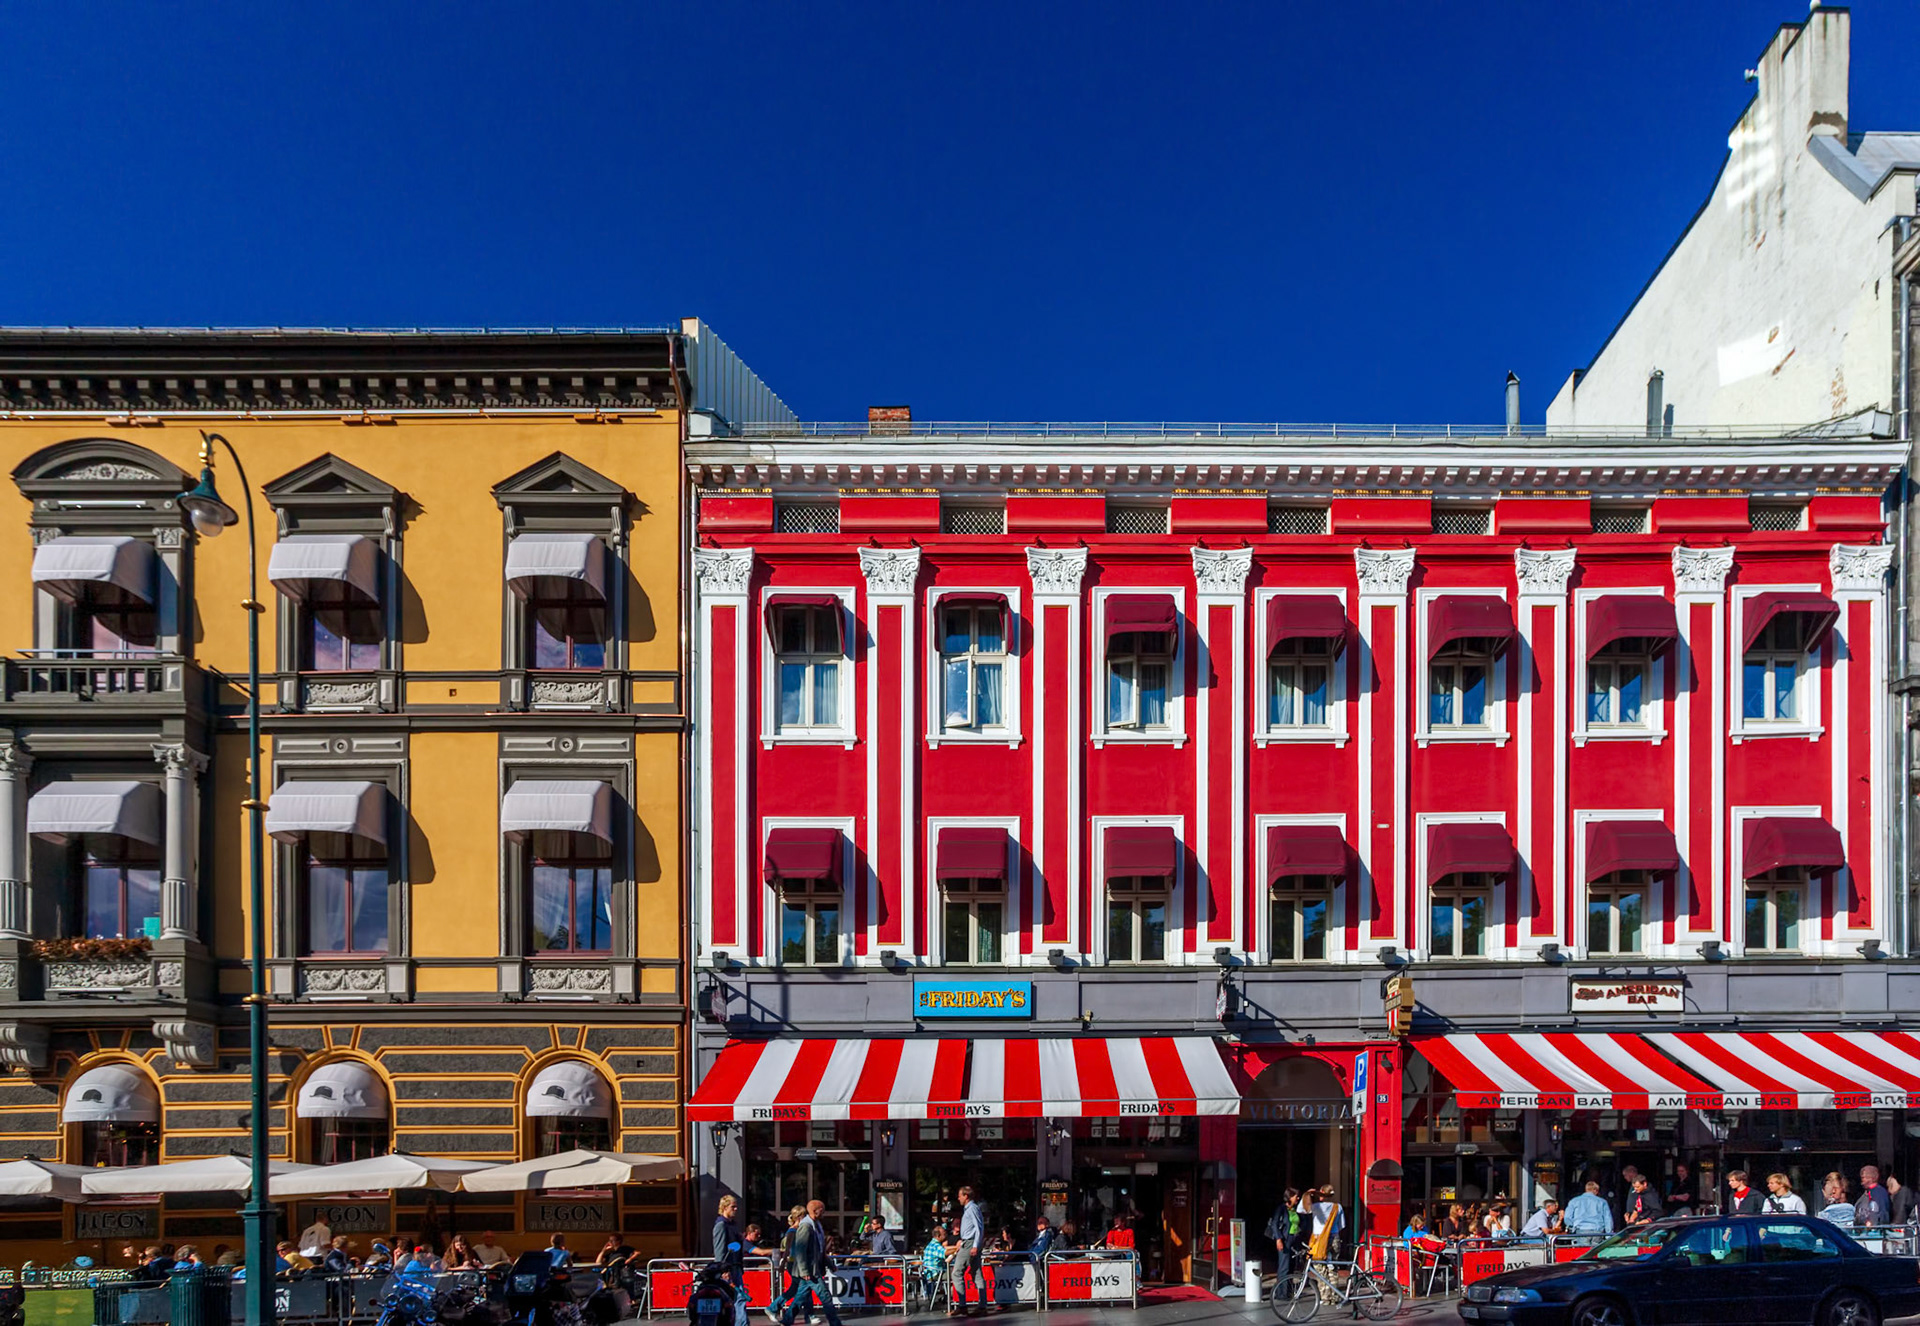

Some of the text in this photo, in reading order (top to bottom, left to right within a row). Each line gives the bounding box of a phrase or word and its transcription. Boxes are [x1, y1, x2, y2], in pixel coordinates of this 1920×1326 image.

[928, 988, 1026, 1008] FRIDAY'S
[1627, 995, 1658, 1004] BAR
[1357, 1058, 1365, 1088] P
[1479, 1096, 1613, 1106] AMERICAN BAR
[1656, 1097, 1791, 1106] AMERICAN BAR
[752, 1107, 807, 1118] FRIDAY'S
[936, 1104, 991, 1115] FRIDAY'S
[1121, 1103, 1175, 1113] FRIDAY'S
[1250, 1104, 1352, 1119] VICTORIA
[541, 1205, 603, 1221] EGON
[832, 1274, 897, 1298] DAY'S
[967, 1278, 1024, 1290] FIDAY'S
[1063, 1275, 1120, 1286] FRIDAY'S
